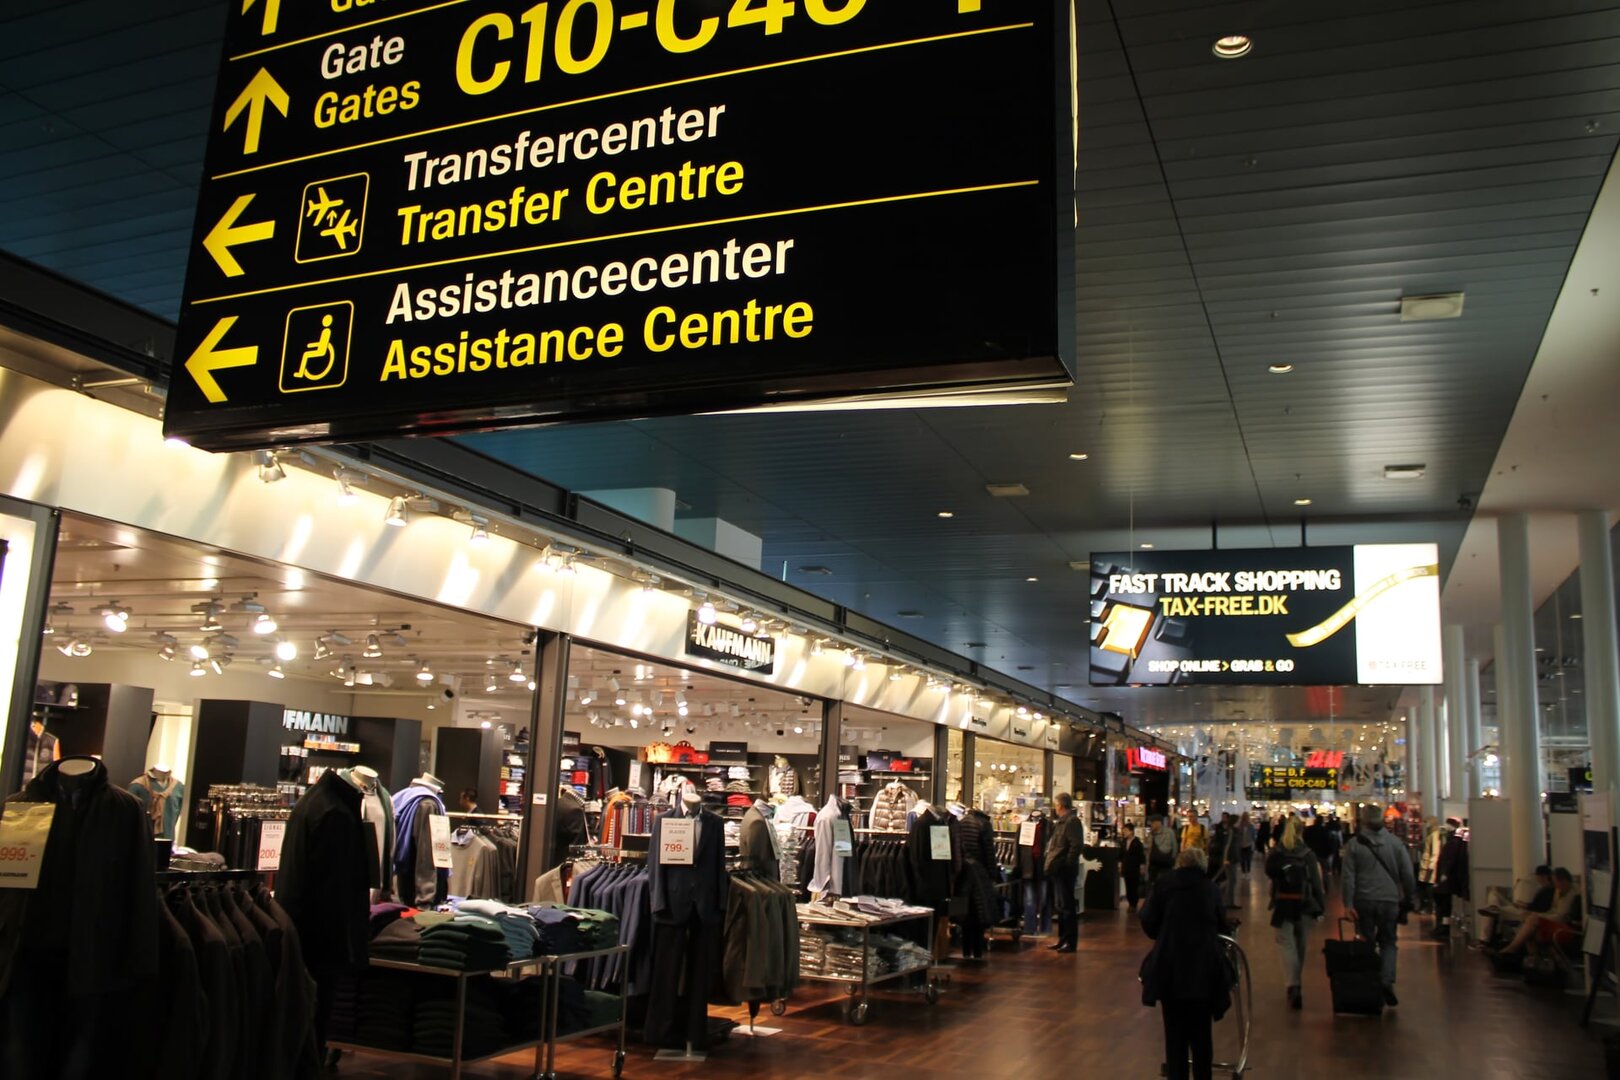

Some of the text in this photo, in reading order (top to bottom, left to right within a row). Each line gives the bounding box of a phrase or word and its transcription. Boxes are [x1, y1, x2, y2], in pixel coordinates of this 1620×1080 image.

[320, 35, 405, 80] Gate
[313, 80, 421, 129] Gates
[403, 104, 726, 192] Transfercenter
[397, 160, 745, 246] Transfer Centre
[385, 238, 795, 325] Assistancecenter
[379, 299, 814, 382] Assistance Centre
[1109, 569, 1341, 594] FAST TRACK SHOPPING
[1159, 595, 1288, 616] TAX-FREE.DK
[695, 622, 771, 665] KAUFMANN
[1148, 660, 1179, 672] SHOP
[1180, 660, 1220, 672] ONLINE
[1230, 660, 1263, 672] GRAB
[1264, 660, 1275, 672] &
[1275, 660, 1294, 672] GO
